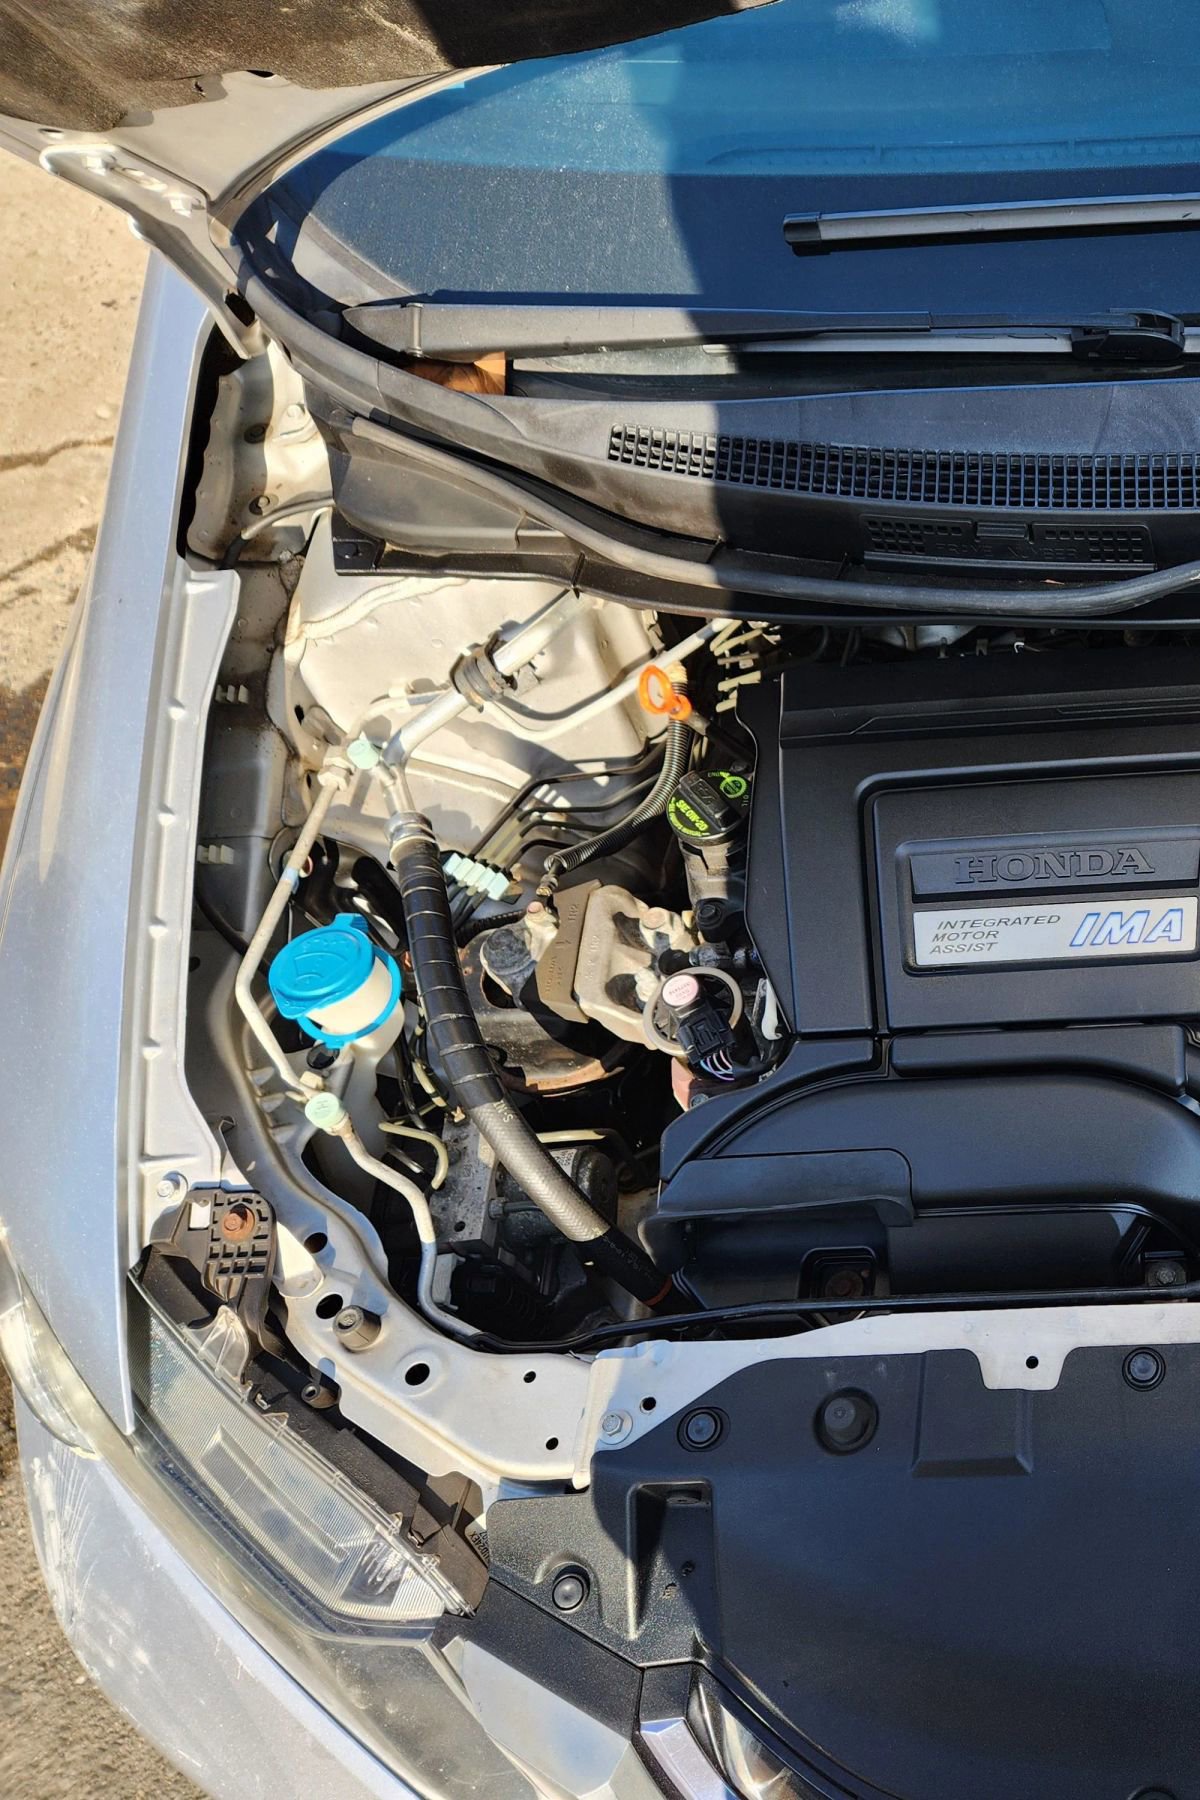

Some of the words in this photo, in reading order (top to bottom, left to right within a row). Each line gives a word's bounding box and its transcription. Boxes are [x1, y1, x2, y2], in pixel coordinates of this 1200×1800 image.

[676, 799, 692, 814] SAE
[953, 846, 1155, 885] HONDA
[936, 914, 1062, 931] INTEGRATED
[1068, 907, 1185, 948] IMA
[932, 929, 1000, 942] MOTOR
[929, 941, 999, 955] ASSIST
